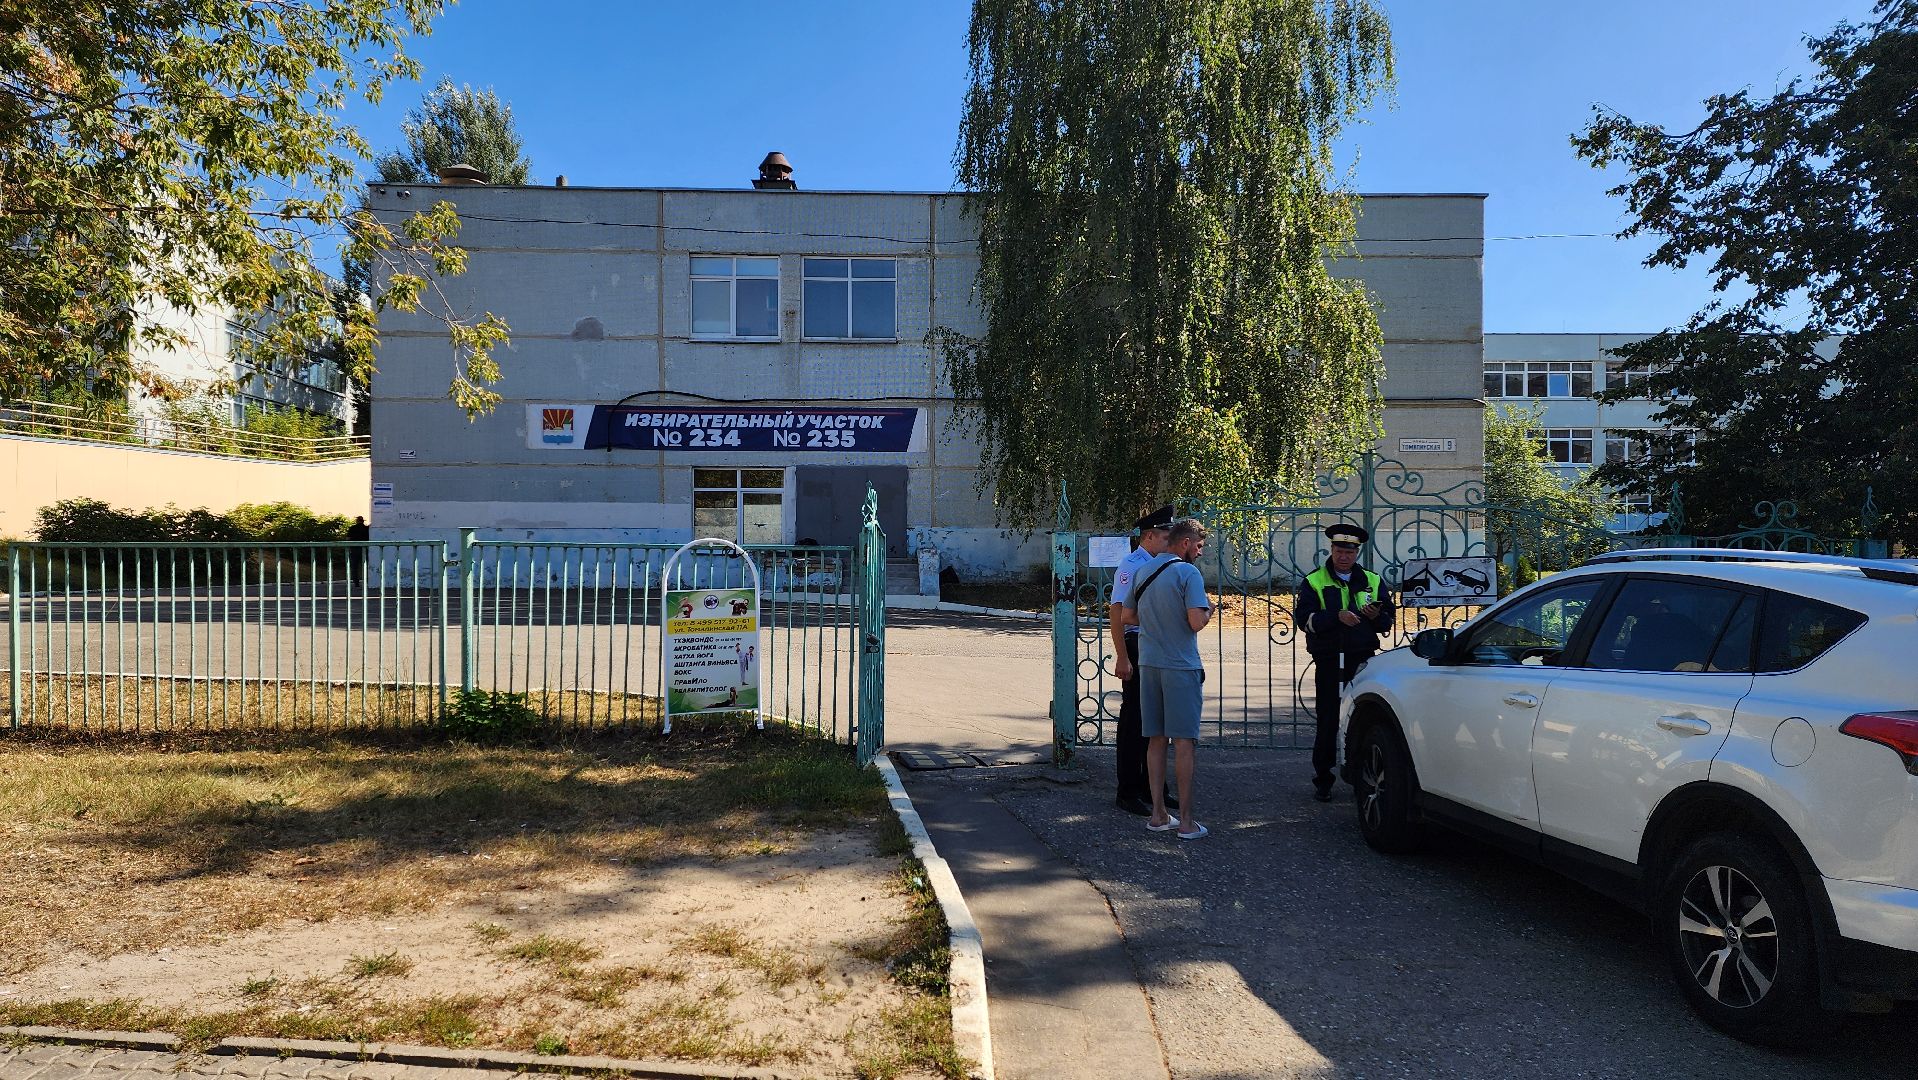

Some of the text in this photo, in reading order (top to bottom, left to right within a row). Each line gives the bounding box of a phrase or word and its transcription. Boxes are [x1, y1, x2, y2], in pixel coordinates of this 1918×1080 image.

[625, 411, 885, 429] ИЗБИРАТЕЛЬНЫЙ УЧАСТОК
[653, 429, 856, 447] № 234 № 235
[1447, 440, 1453, 451] 9
[673, 659, 738, 668] АШТАНГА ВИНЬЯСА
